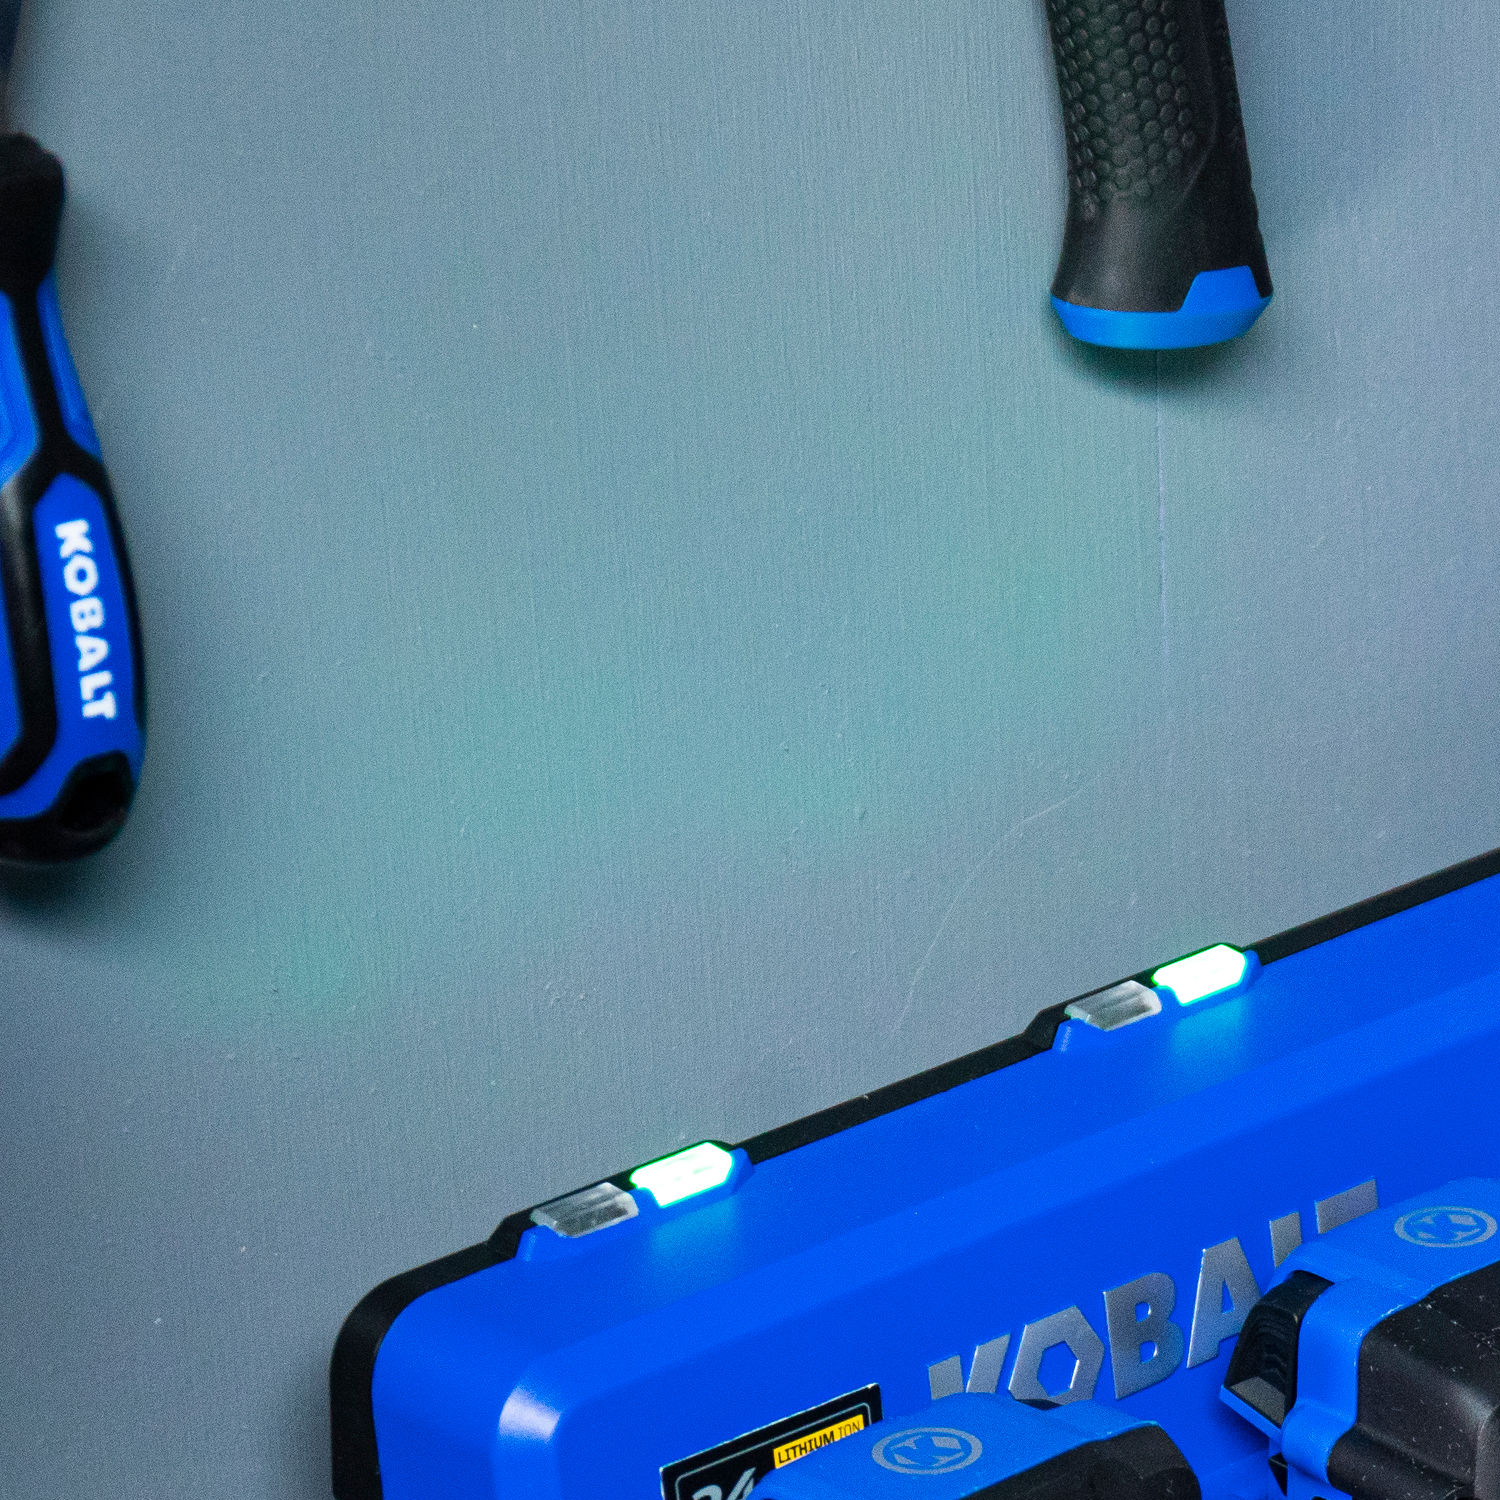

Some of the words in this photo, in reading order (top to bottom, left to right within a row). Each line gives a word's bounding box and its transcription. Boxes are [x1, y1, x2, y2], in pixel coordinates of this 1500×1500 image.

[55, 519, 117, 720] KOBALT
[777, 1429, 836, 1464] LITHIUM
[838, 1419, 862, 1442] ION
